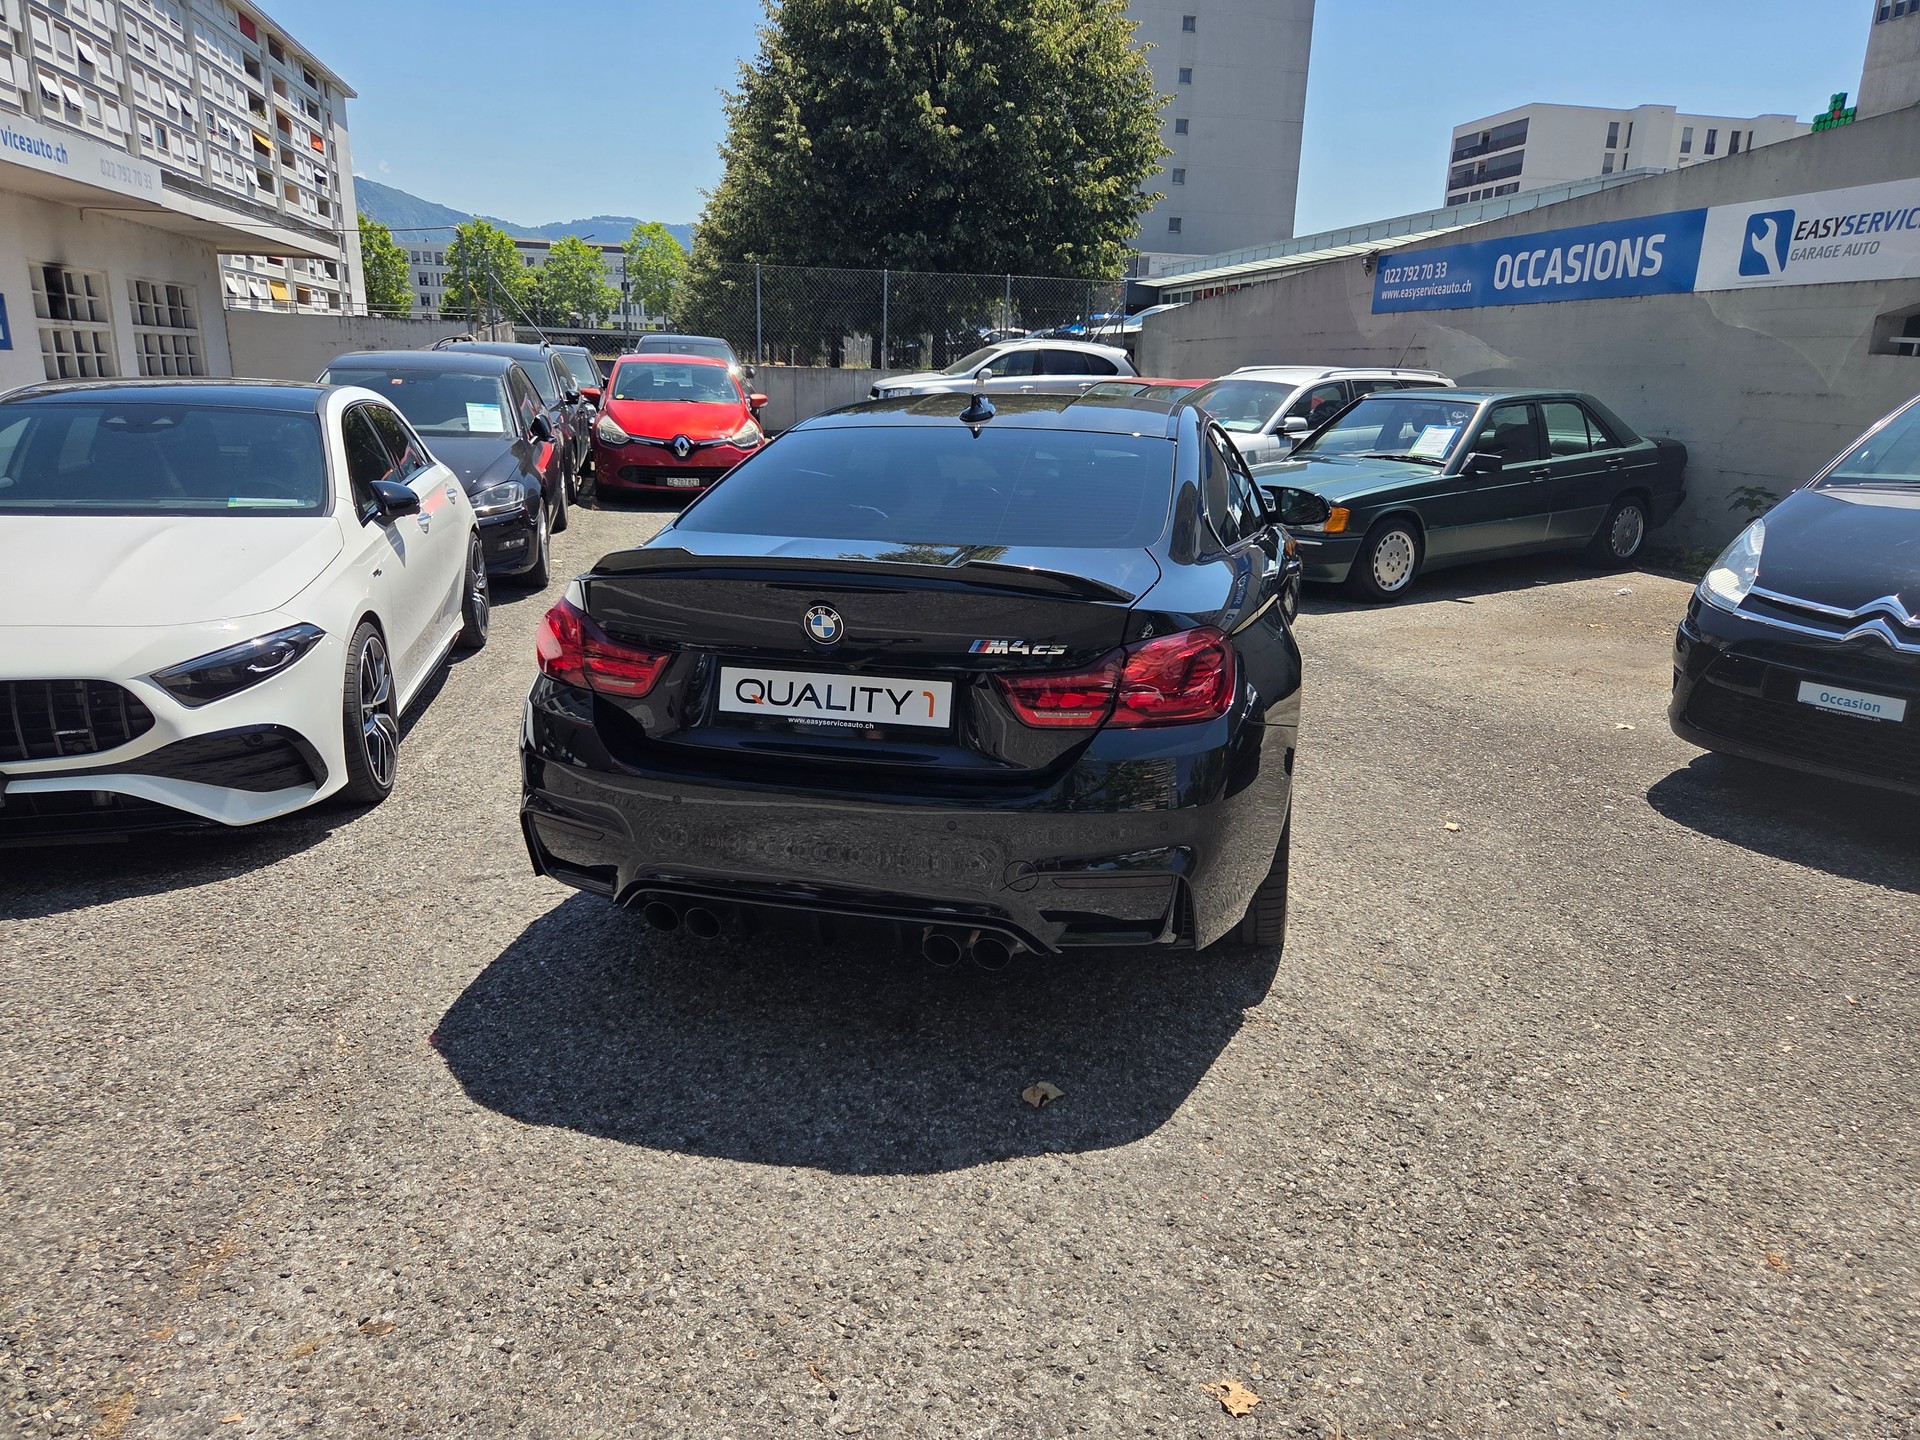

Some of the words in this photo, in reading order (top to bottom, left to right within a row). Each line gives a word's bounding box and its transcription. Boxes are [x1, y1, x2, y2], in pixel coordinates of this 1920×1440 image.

[100, 158, 116, 179] 022
[1790, 244, 1842, 261] GARAGE
[1842, 240, 1881, 257] AUTO
[1493, 233, 1666, 290] OCCASIONS
[1384, 267, 1401, 284] 022
[1402, 265, 1420, 282] 792
[1420, 263, 1434, 280] 70
[1434, 261, 1448, 279] 33
[1381, 279, 1472, 300] www.easyserviceauto.ch
[808, 607, 840, 621] BMW
[735, 678, 913, 716] QUALITY
[922, 690, 935, 718] 1
[1820, 692, 1881, 713] Occasion
[788, 716, 874, 730] www.easyserviceauto.ch
